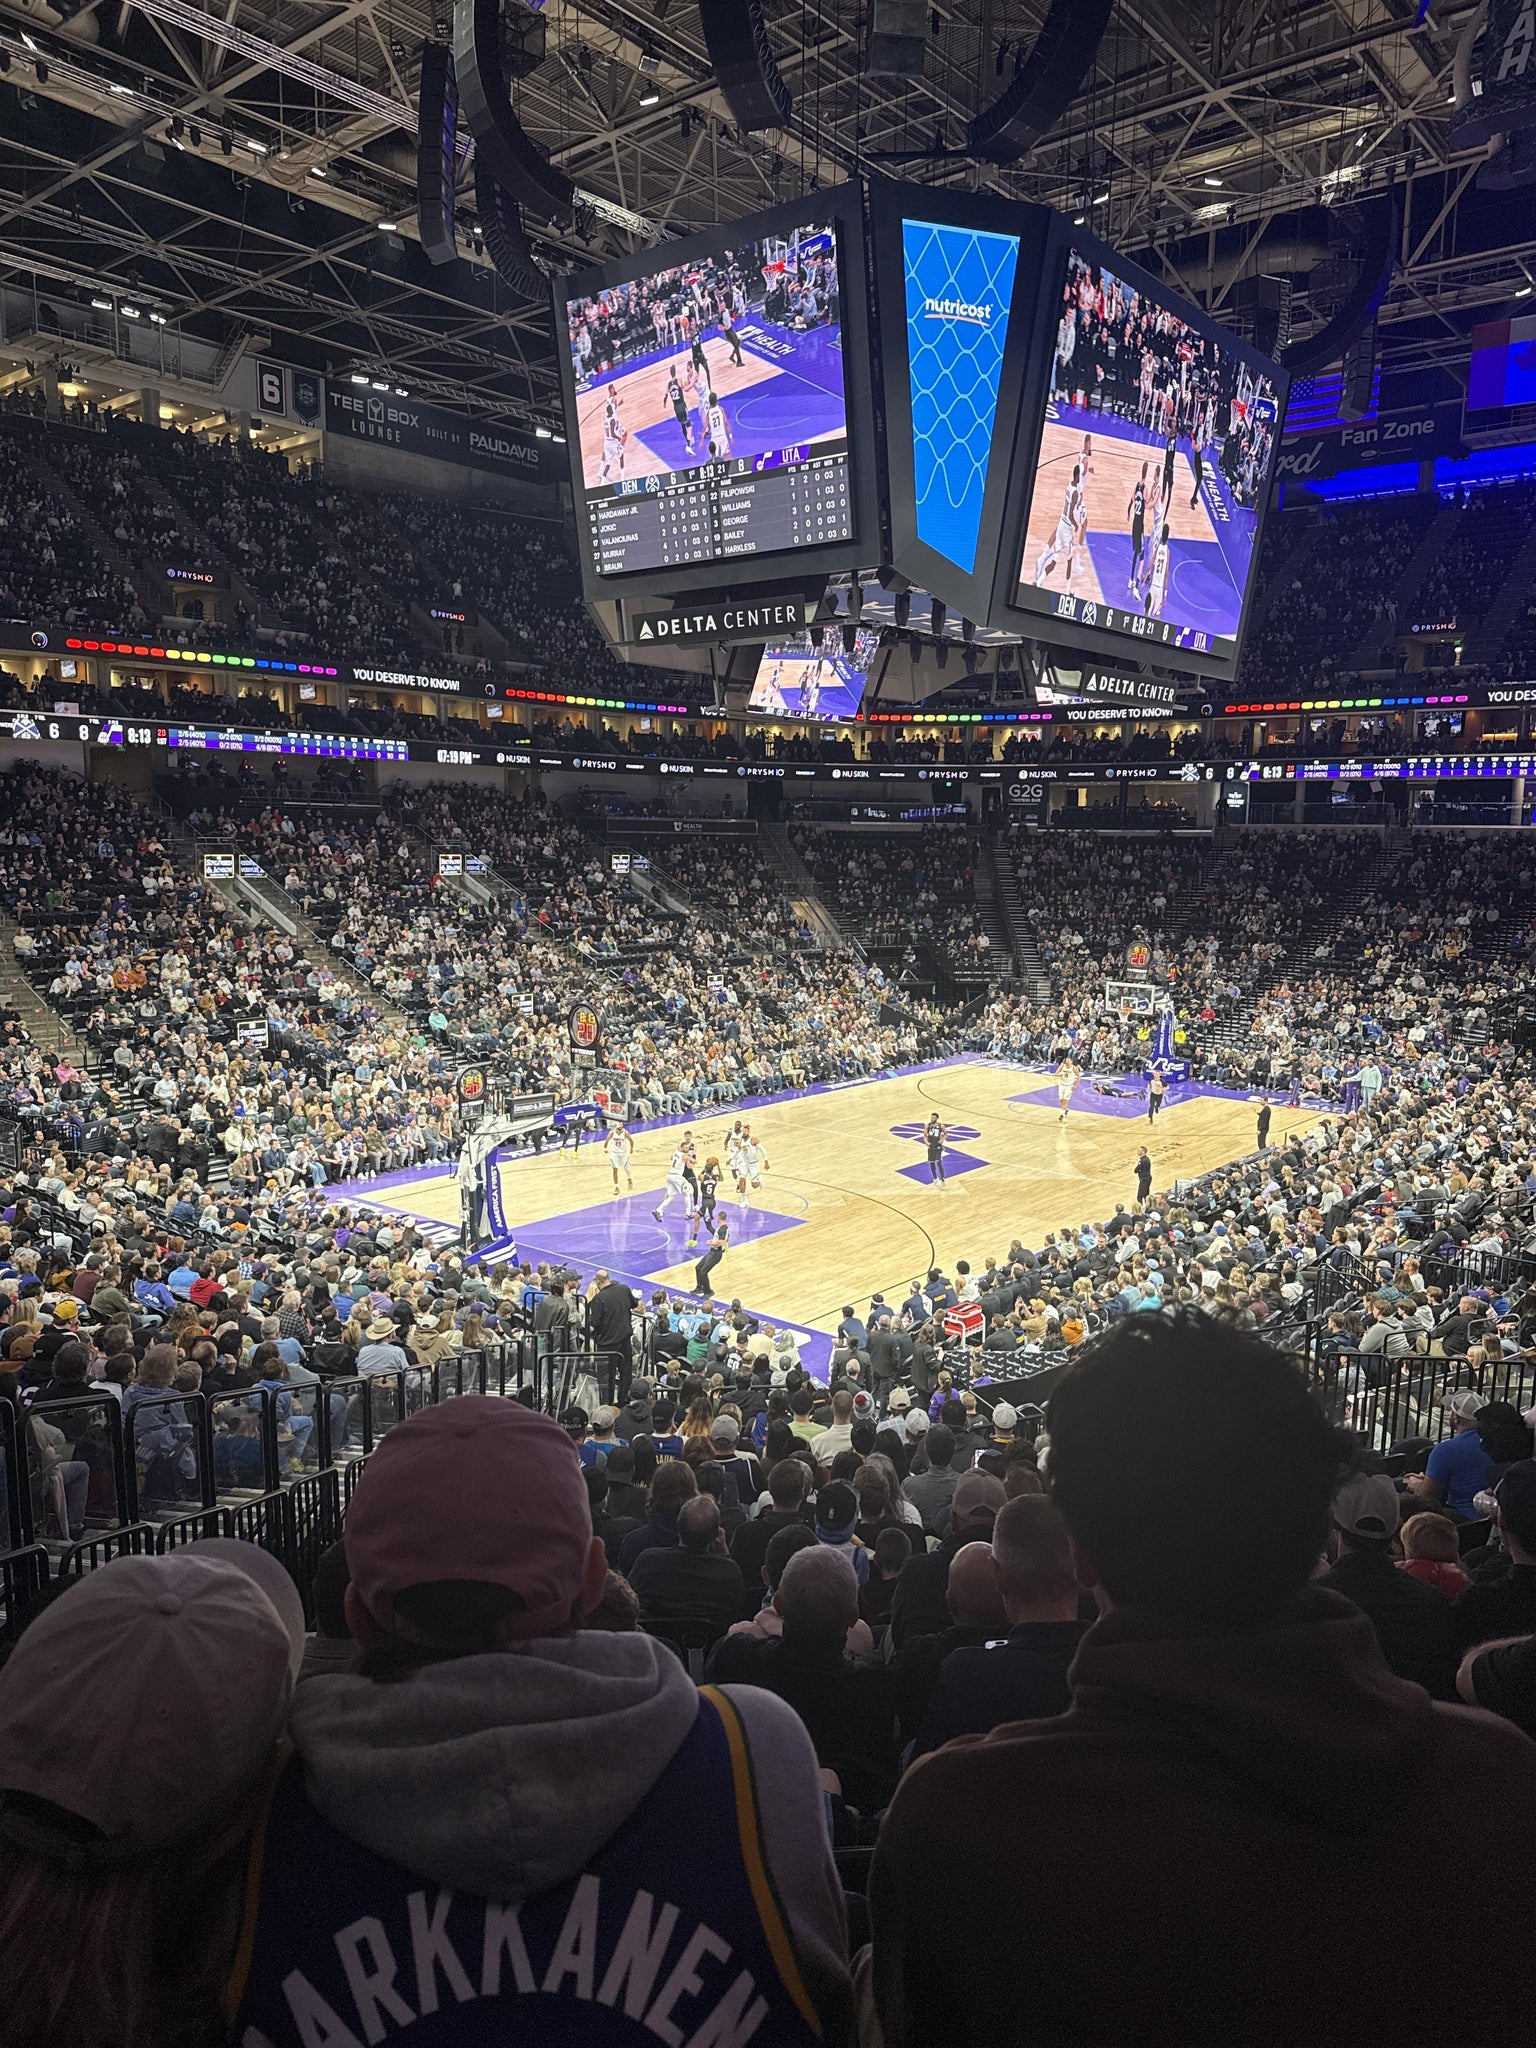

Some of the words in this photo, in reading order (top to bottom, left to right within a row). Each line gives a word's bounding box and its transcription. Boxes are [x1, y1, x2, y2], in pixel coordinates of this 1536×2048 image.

[1496, 0, 1534, 80] AH
[925, 299, 991, 319] nutricost
[751, 334, 797, 355] HEALTH
[263, 373, 280, 404] 6
[329, 391, 364, 414] TEE
[387, 408, 420, 429] BOX
[352, 418, 401, 443] LOUNGE
[426, 426, 448, 440] BUILT
[1341, 428, 1378, 447] Fan
[1383, 419, 1435, 441] Zone
[469, 432, 539, 463] PAUDAVIS
[1276, 441, 1324, 477] rd
[621, 480, 638, 494] DEN
[670, 472, 677, 485] 6
[699, 465, 714, 479] 8:13
[717, 464, 726, 474] 21
[738, 459, 745, 472] 8
[782, 447, 800, 462] UTA
[710, 492, 718, 500] 22
[720, 485, 755, 498] FILIPOWSKI
[790, 478, 795, 486] 2
[803, 475, 808, 483] 2
[815, 473, 820, 481] 0
[824, 471, 834, 480] 03
[839, 469, 843, 477] 1
[598, 508, 629, 520] HARDAWAY
[680, 498, 685, 506] 0
[701, 494, 706, 502] 0
[712, 506, 717, 514] 5
[722, 500, 751, 512] WILLIAMS
[792, 492, 796, 500] 1
[804, 490, 808, 498] 1
[816, 488, 820, 496] 1
[825, 486, 834, 494] 03
[839, 484, 845, 492] 0
[1206, 480, 1231, 522] HEALTH
[591, 526, 598, 534] 15
[600, 524, 617, 533] JOKIC
[660, 515, 665, 523] 0
[671, 513, 676, 521] 0
[681, 511, 686, 519] 0
[690, 509, 698, 518] 03
[702, 508, 707, 516] 0
[713, 520, 719, 528] 3
[723, 515, 749, 526] GEORGE
[792, 507, 797, 515] 3
[805, 505, 810, 513] 0
[817, 503, 822, 511] 0
[826, 500, 835, 509] 03
[840, 498, 846, 507] 0
[592, 539, 599, 547] 17
[601, 534, 639, 546] VALANCIUNAS
[682, 525, 687, 533] 0
[691, 523, 699, 532] 03
[703, 521, 708, 529] 1
[724, 530, 745, 540] BAILEY
[793, 521, 798, 529] 2
[806, 519, 811, 528] 0
[817, 517, 823, 525] 0
[827, 515, 836, 524] 03
[842, 513, 846, 521] 1
[593, 552, 600, 560] 27
[602, 549, 626, 560] MURRAY
[674, 540, 678, 548] 1
[684, 538, 688, 546] 1
[692, 537, 701, 545] 03
[704, 535, 709, 543] 0
[725, 542, 756, 554] HARKLESS
[794, 535, 799, 543] 0
[806, 533, 812, 541] 0
[818, 531, 824, 539] 0
[828, 529, 837, 538] 03
[842, 527, 847, 536] 0
[596, 565, 601, 573] 0
[604, 562, 623, 572] BRAUN
[664, 555, 669, 563] 0
[684, 552, 690, 560] 0
[693, 550, 702, 559] 03
[177, 571, 203, 582] PRYSM
[437, 611, 457, 621] PRYSM
[657, 615, 717, 637] DELTA
[723, 605, 796, 629] CENTER
[1057, 595, 1077, 615] DEN
[1106, 609, 1113, 627] 6
[1132, 616, 1145, 635] 8:13
[1146, 621, 1155, 634] 21
[1162, 624, 1169, 641] 8
[1193, 631, 1207, 649] UTA
[353, 668, 373, 681] YOU
[375, 671, 416, 686] DESERVE
[416, 675, 429, 688] TO
[430, 678, 460, 691] KNOW!
[1099, 676, 1135, 696] DELTA
[1137, 682, 1175, 703] CENTER
[1488, 690, 1512, 702] YOU
[1067, 710, 1086, 720] YOU
[1088, 708, 1127, 719] DESERVE
[1127, 709, 1141, 718] TO
[1142, 708, 1173, 718] KNOW!
[49, 723, 60, 739] 6
[79, 724, 89, 741] 8
[127, 727, 152, 744] 8:13
[157, 729, 166, 737] 20
[157, 737, 167, 745] 1ST
[437, 749, 459, 764] 07:19
[460, 751, 473, 765] PM
[506, 755, 515, 763] NU
[516, 755, 531, 764] SKIN
[582, 760, 607, 769] PRYSM
[679, 765, 694, 773] SKIN
[747, 768, 775, 776] PRYSM
[1116, 769, 1146, 777] PRYSM
[1206, 768, 1213, 780] 6
[1227, 767, 1234, 779] 8
[1263, 766, 1282, 779] 8:13
[1009, 784, 1043, 797] G2G
[490, 1165, 499, 1190] FIRST
[706, 1184, 713, 1195] 5
[492, 1190, 504, 1228] AMERICA
[241, 1873, 770, 2048] ARKKANEN
